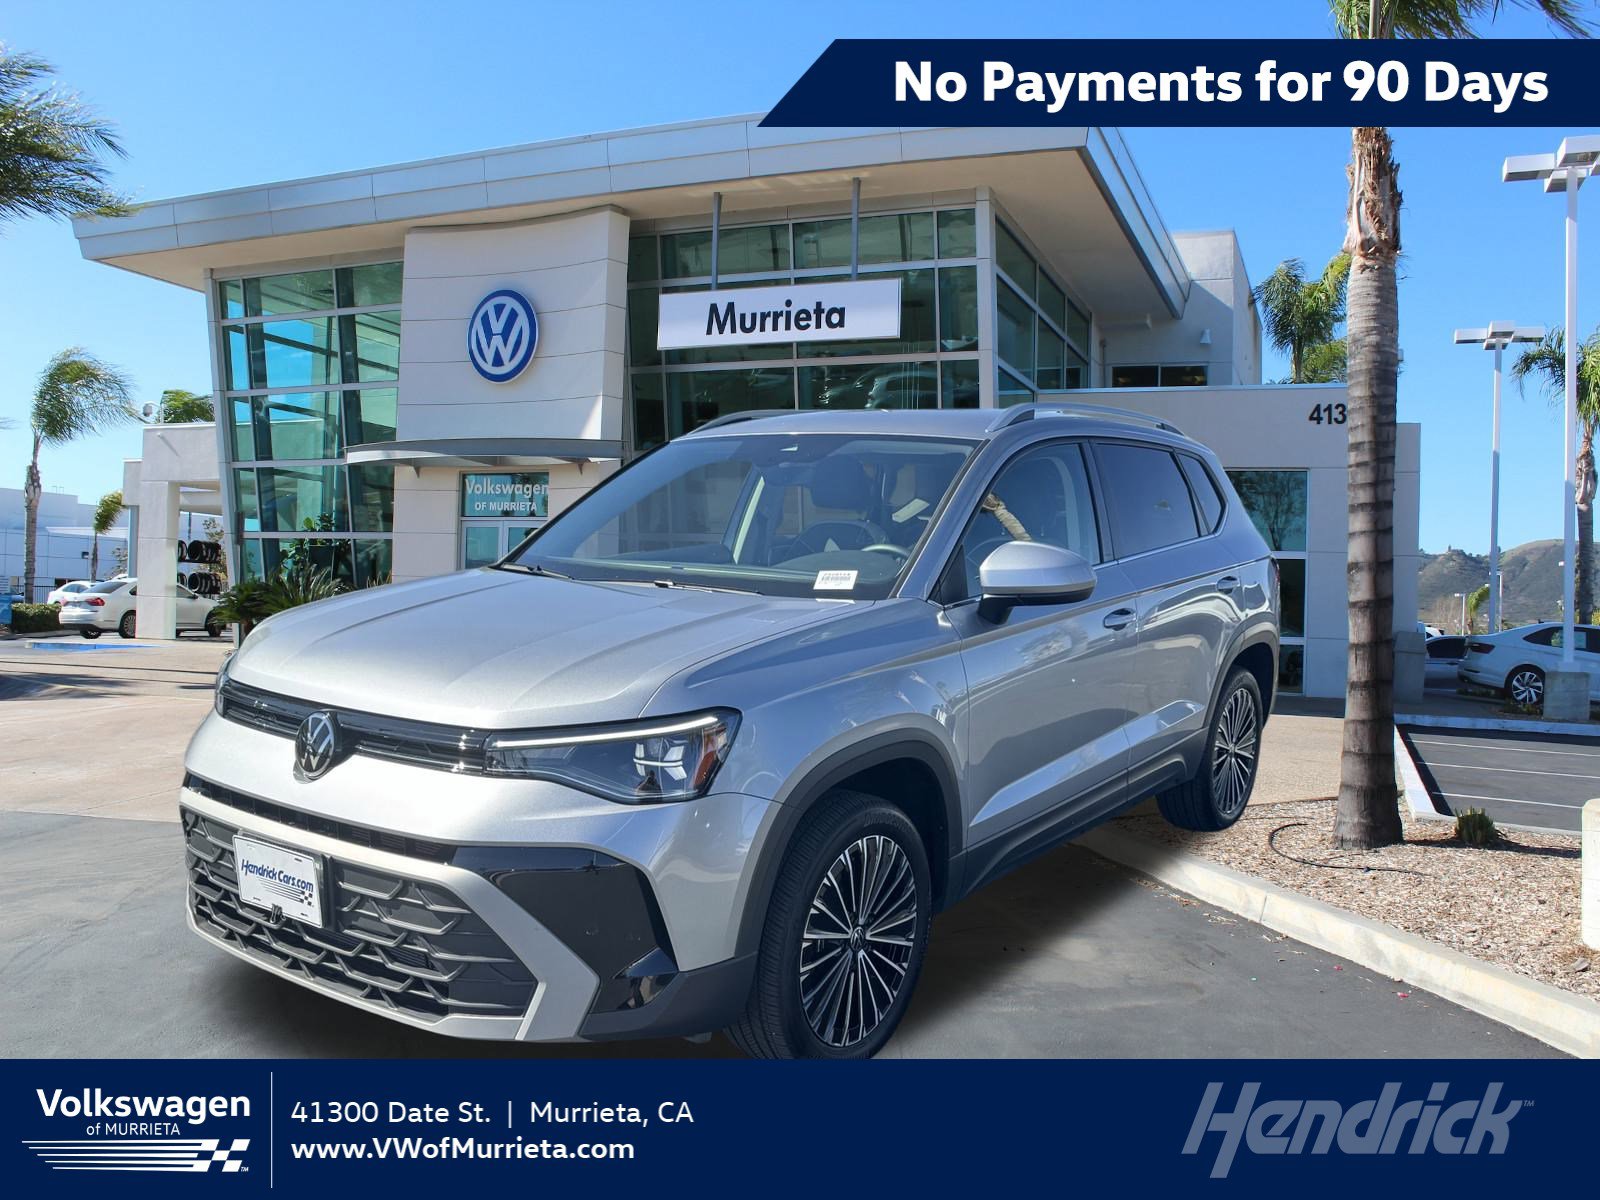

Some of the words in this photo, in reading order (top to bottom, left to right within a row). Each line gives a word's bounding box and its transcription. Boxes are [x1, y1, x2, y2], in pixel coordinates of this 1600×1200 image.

[705, 298, 846, 336] Murrieta
[465, 477, 550, 499] Volkswagen
[474, 501, 487, 511] OF
[489, 501, 538, 511] MURRIETA
